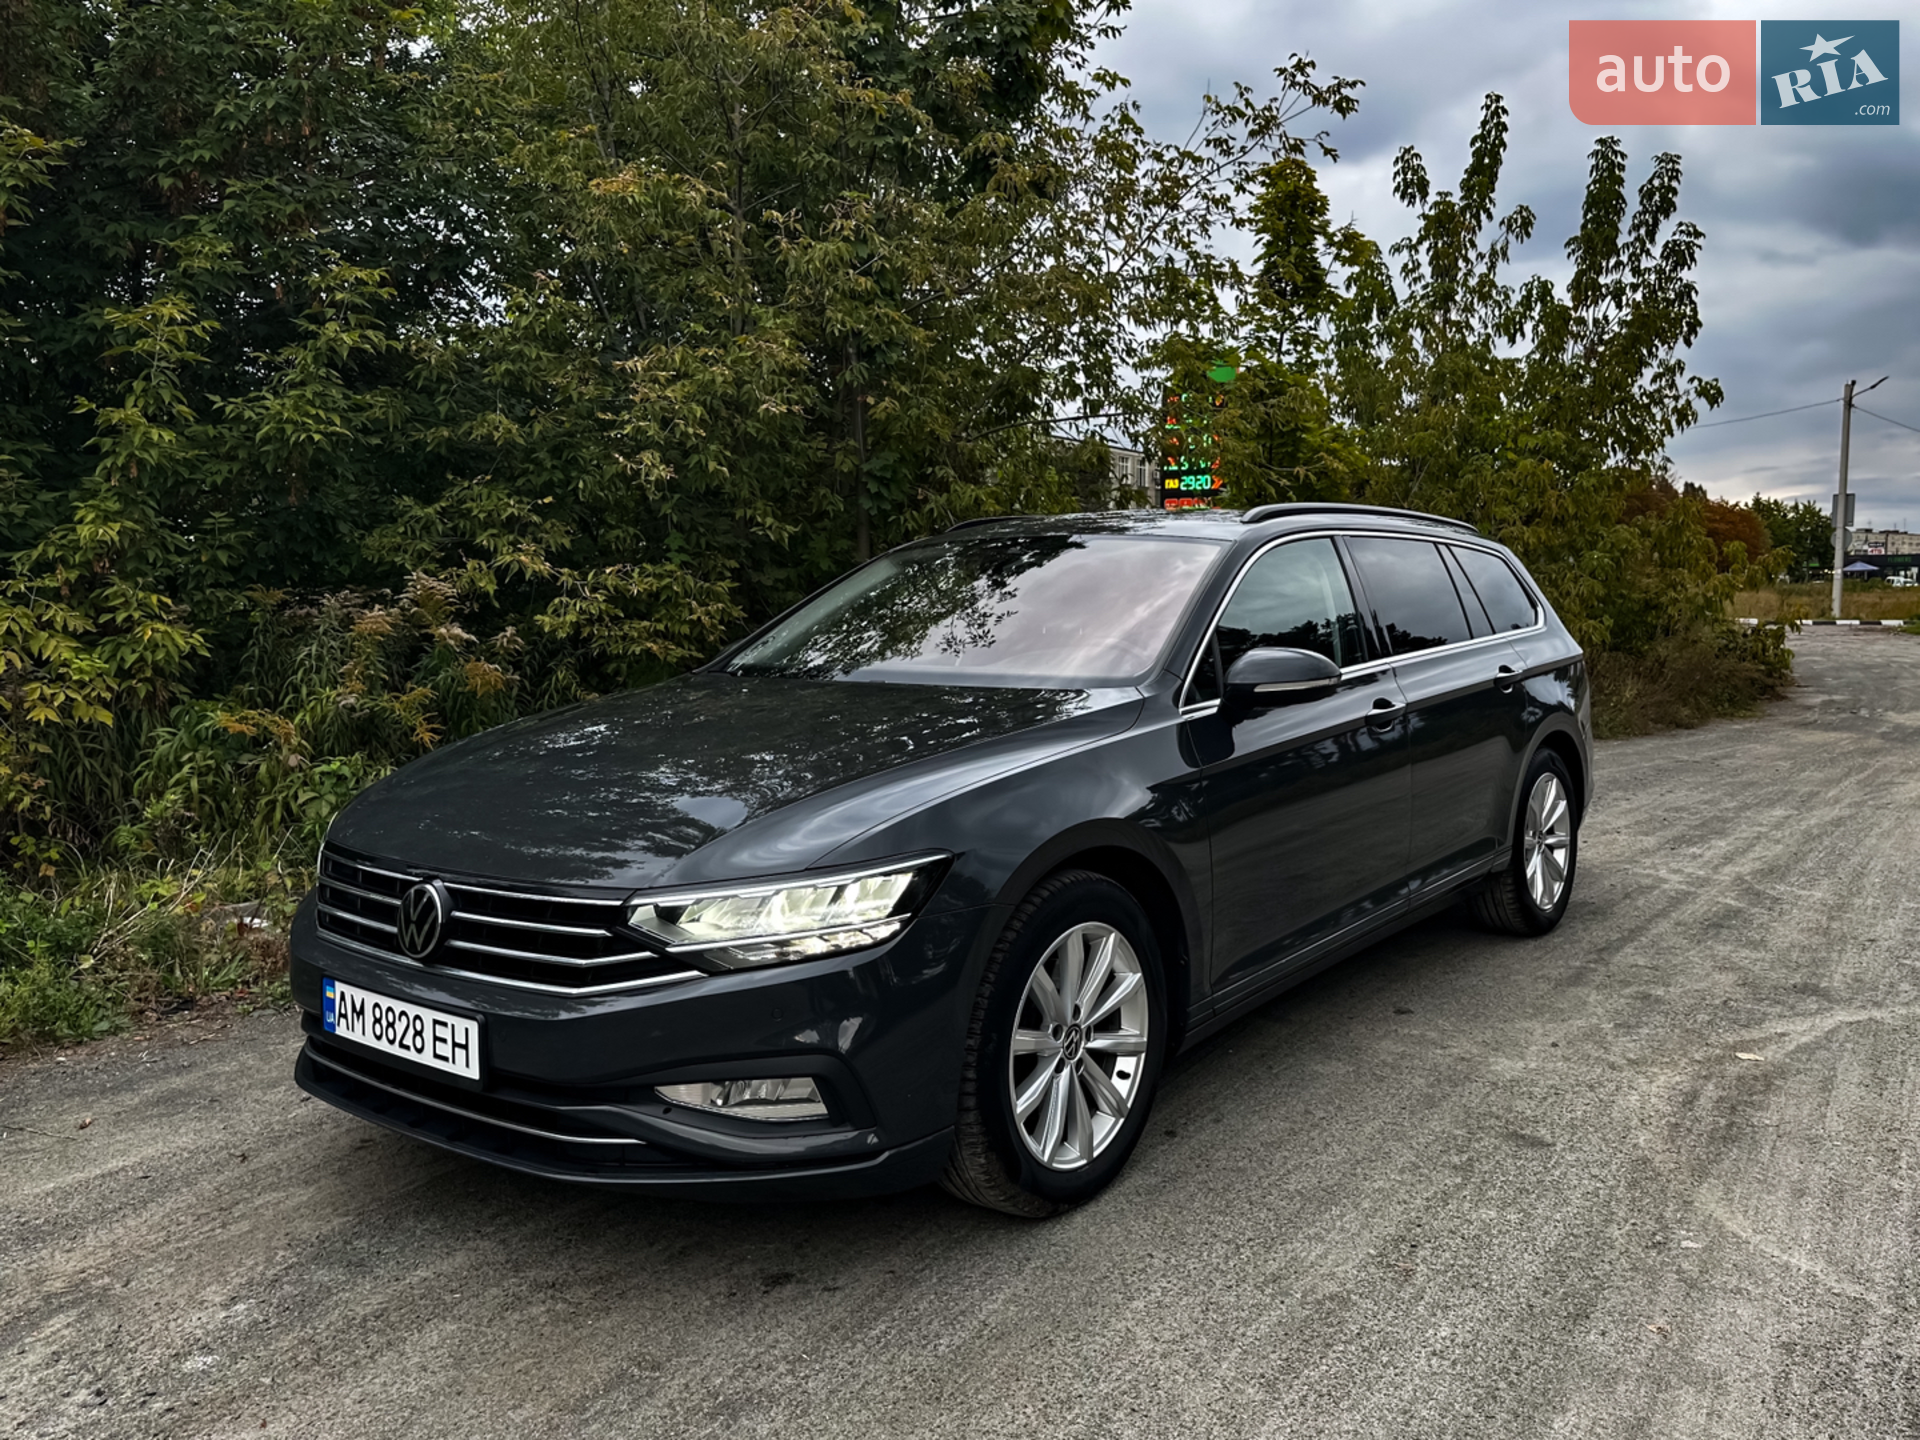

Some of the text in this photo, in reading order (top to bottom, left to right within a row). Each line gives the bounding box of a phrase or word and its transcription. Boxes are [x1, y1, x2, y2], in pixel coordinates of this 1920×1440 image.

[325, 1011, 335, 1023] UA
[337, 990, 470, 1069] AM 8828 EH
